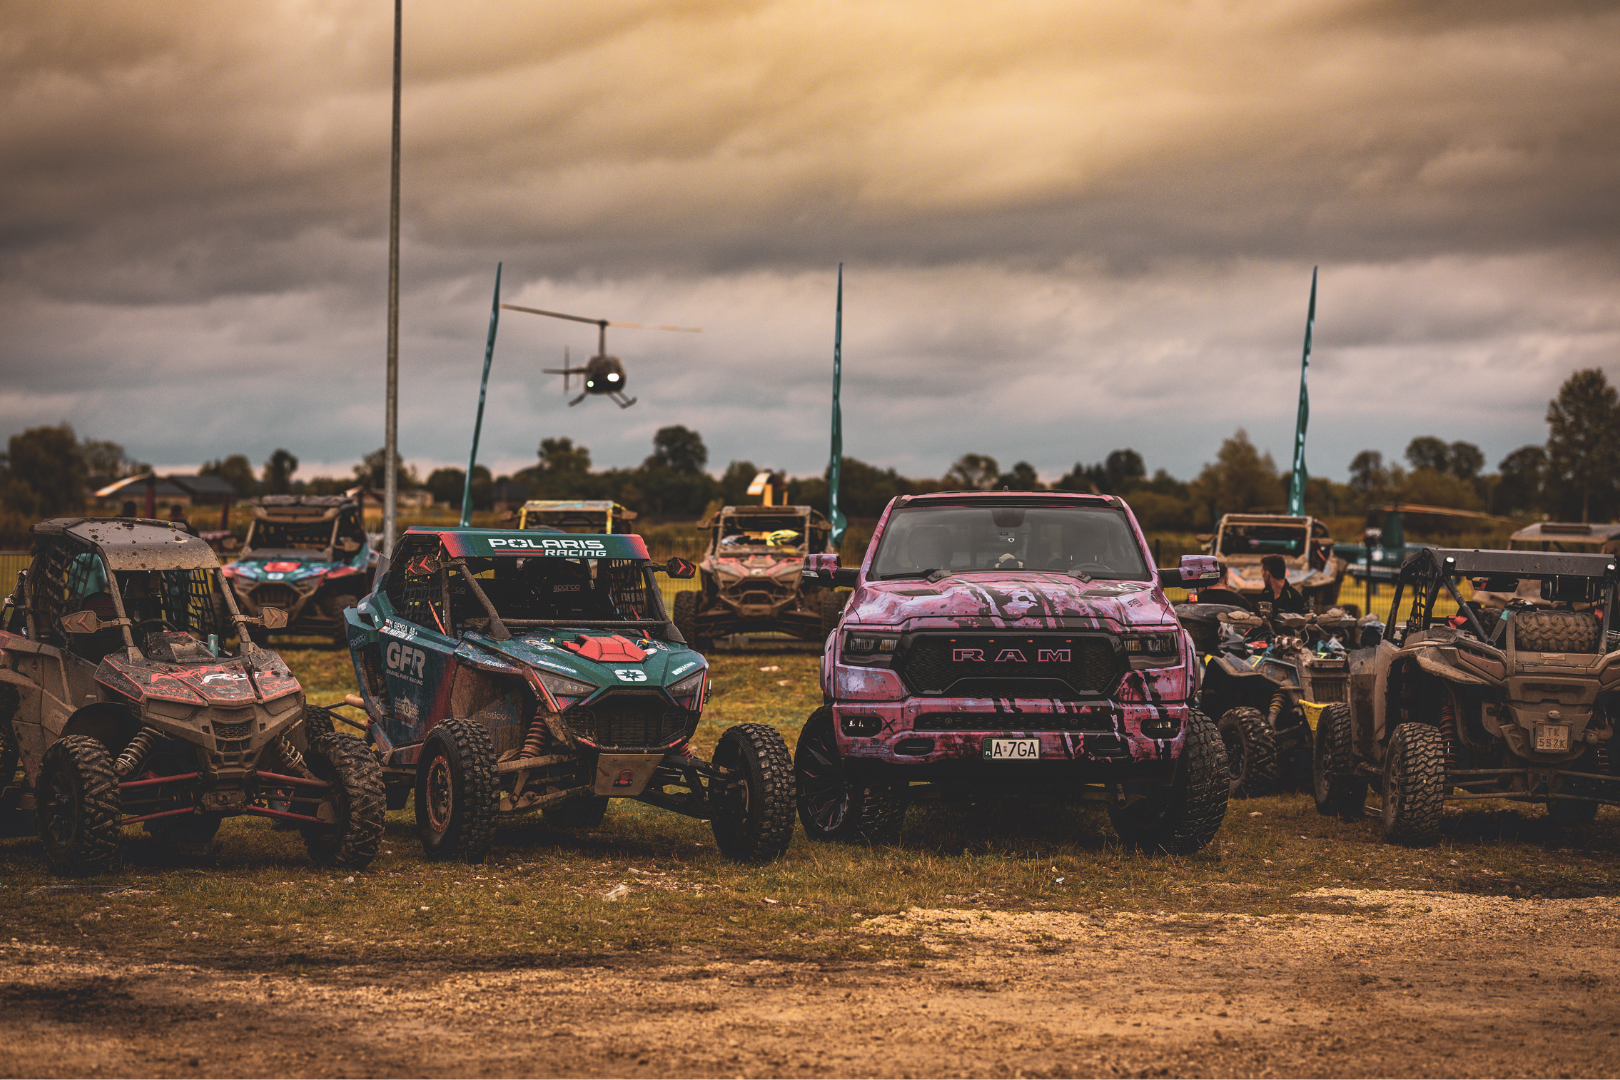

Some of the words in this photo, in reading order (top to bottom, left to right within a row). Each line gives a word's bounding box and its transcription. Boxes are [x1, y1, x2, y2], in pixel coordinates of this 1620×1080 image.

[487, 538, 605, 549] POLARIS
[544, 549, 607, 557] RACING
[553, 584, 581, 593] sparco
[386, 641, 426, 679] GFR
[952, 648, 1072, 662] RAM
[1547, 727, 1560, 737] TK
